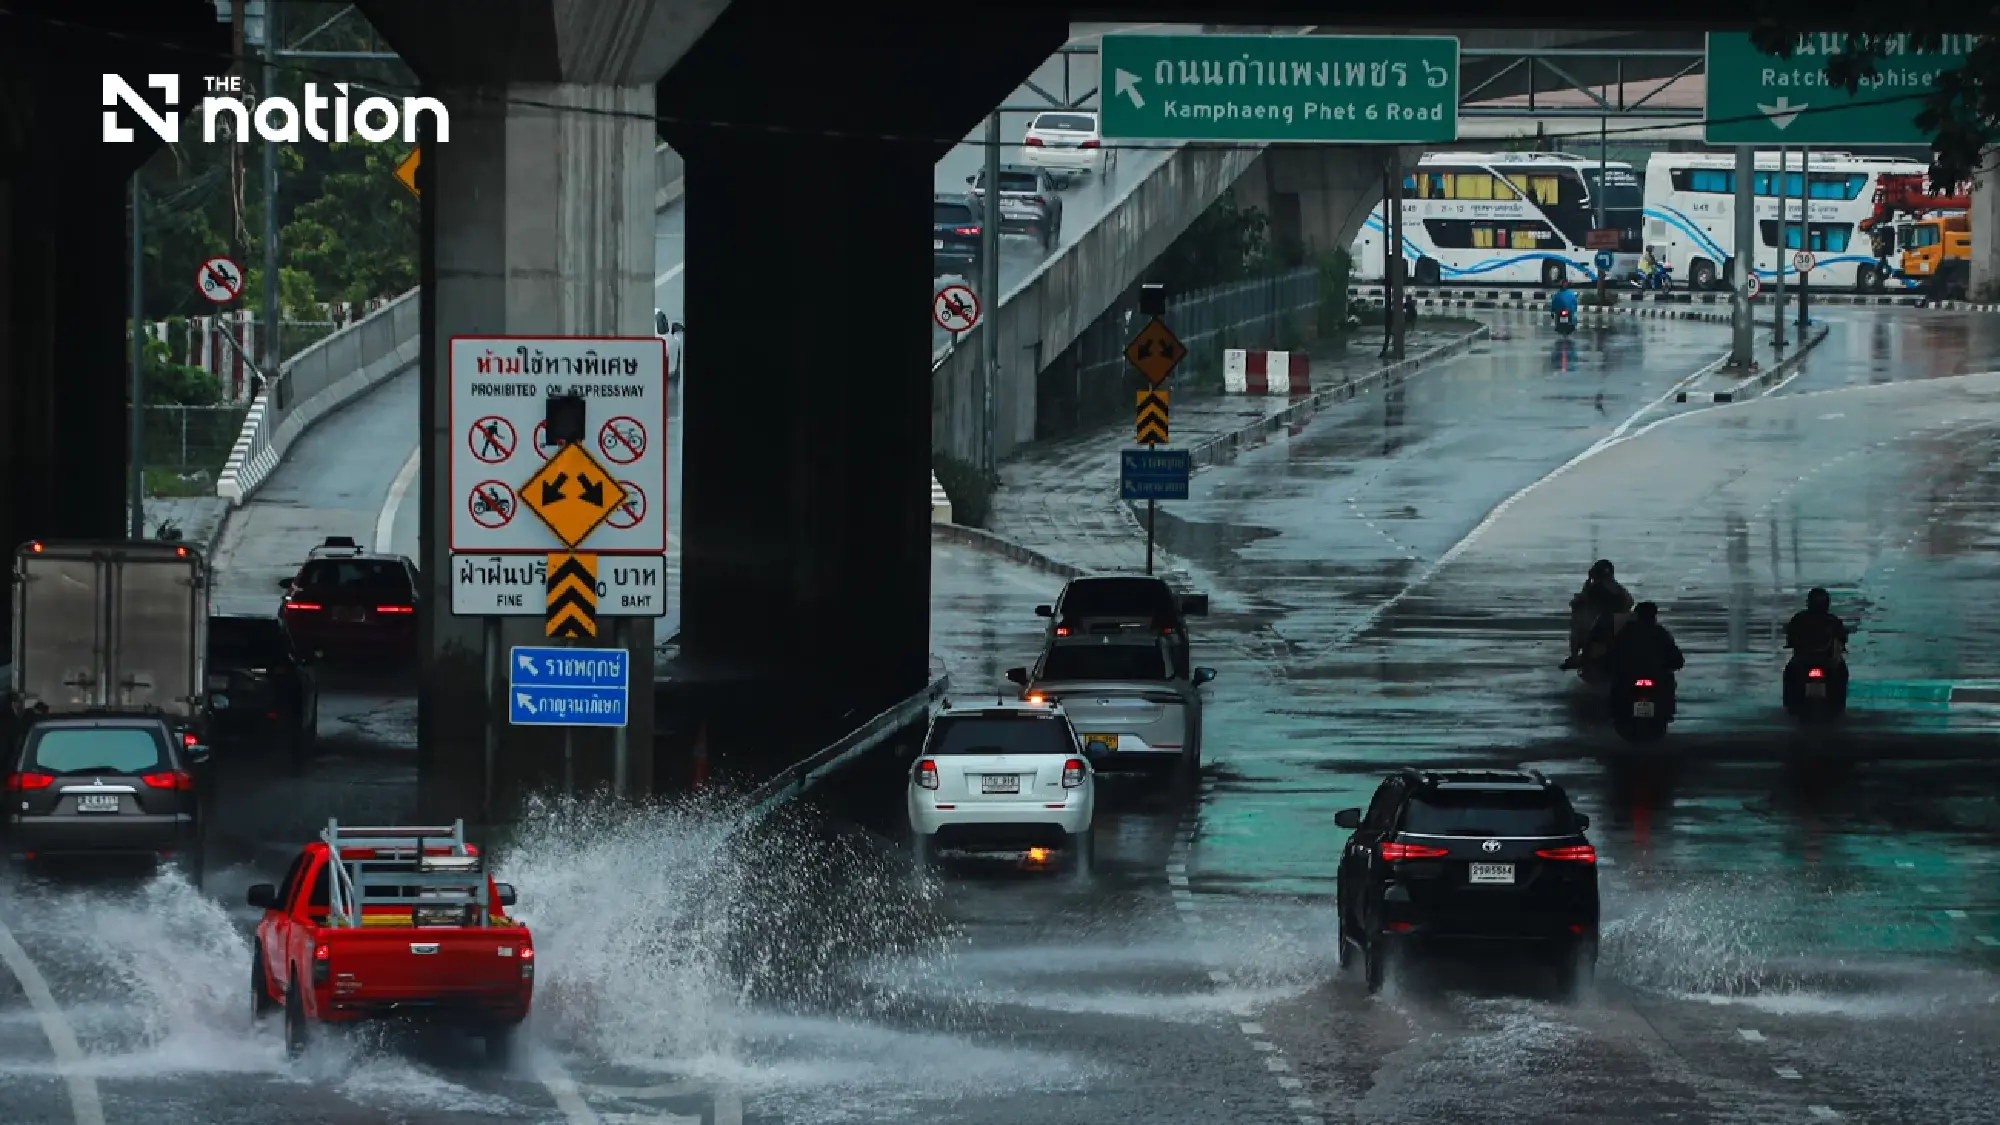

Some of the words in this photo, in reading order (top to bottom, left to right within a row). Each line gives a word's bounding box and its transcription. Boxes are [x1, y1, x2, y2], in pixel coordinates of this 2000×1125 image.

[1154, 53, 1407, 86] ถนนกำแพงเพชร
[1422, 58, 1448, 87] ๖
[1164, 101, 1293, 124] Kamphaeng
[1304, 102, 1356, 120] Phet
[1365, 103, 1378, 120] 6
[1387, 102, 1443, 121] Road
[476, 346, 638, 375] ห้ามใช้ทางพิเศษ
[471, 383, 536, 397] PROHIBITED
[460, 557, 548, 585] ฝ่าฝืนปรั
[613, 568, 656, 585] บาท
[496, 594, 523, 607] FINE
[621, 595, 652, 607] BAHT
[545, 653, 621, 683] ราชพฤกษ์
